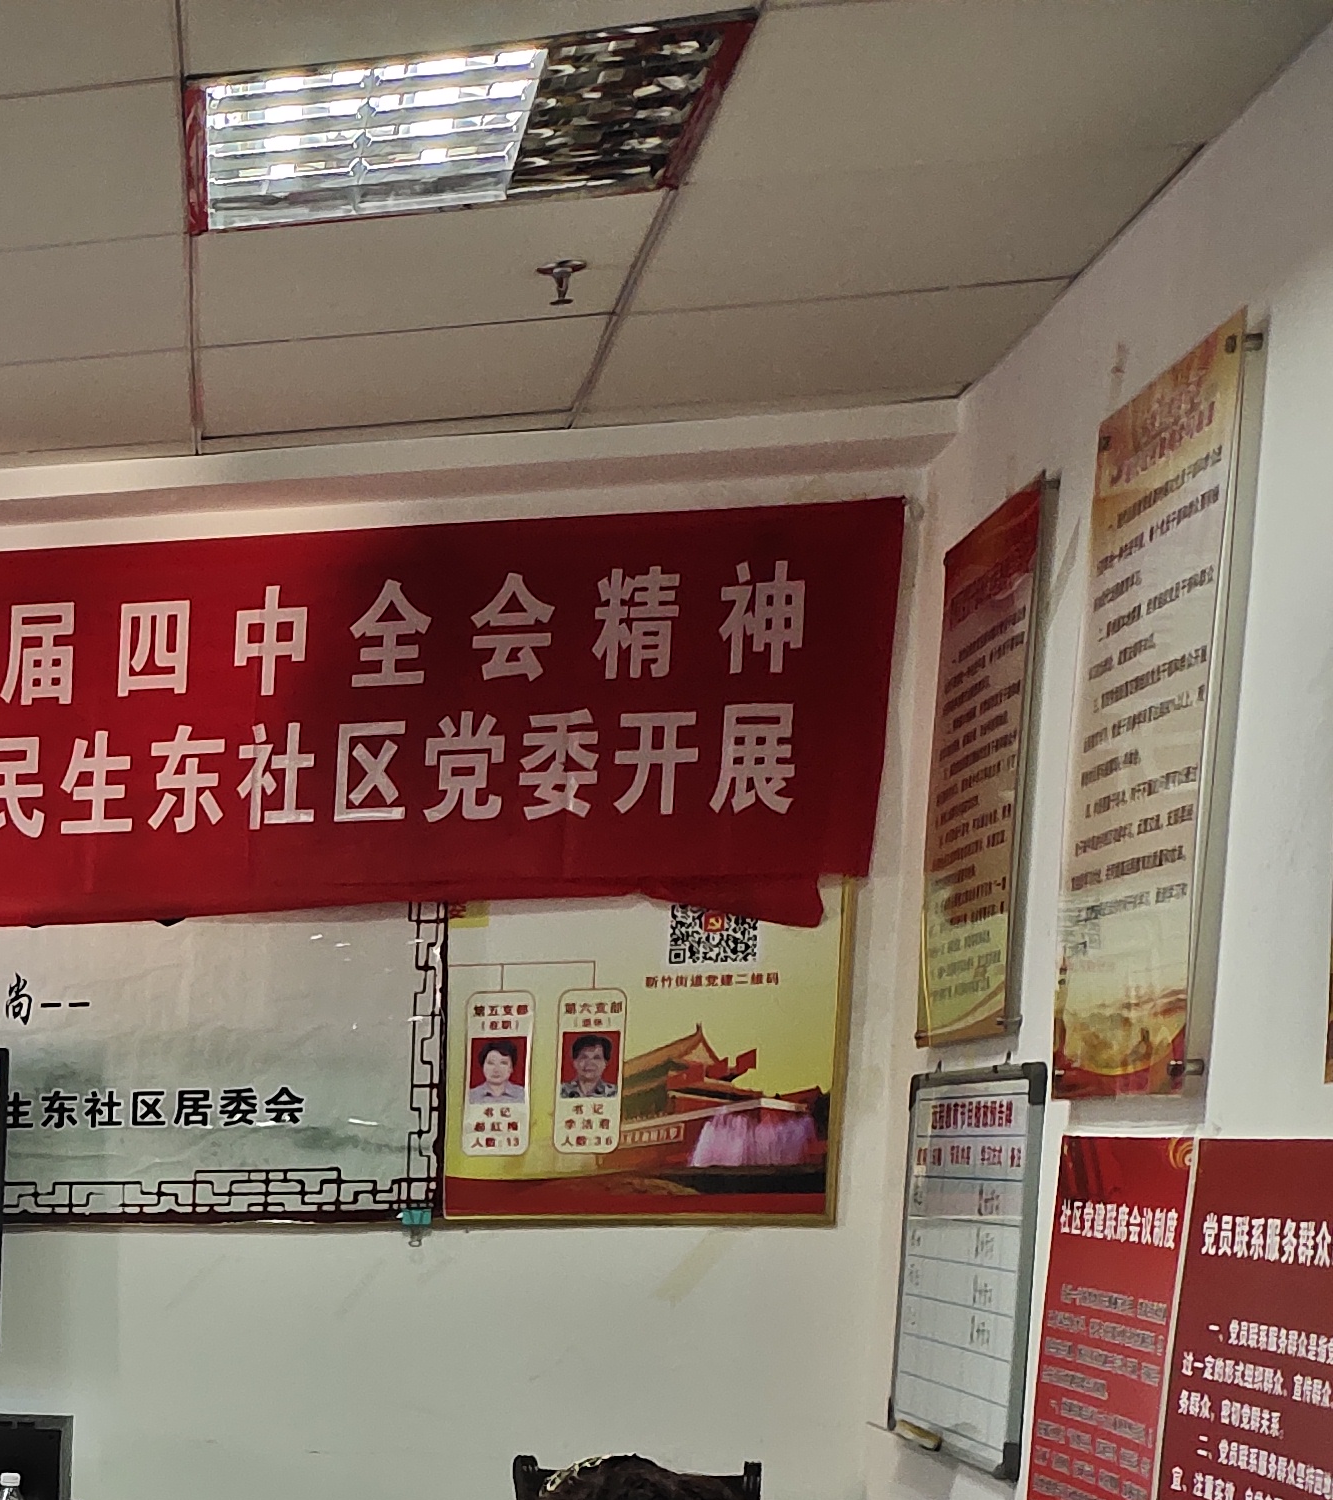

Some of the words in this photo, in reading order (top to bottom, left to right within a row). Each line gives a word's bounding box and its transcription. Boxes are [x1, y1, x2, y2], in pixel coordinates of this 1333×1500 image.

[1060, 1200, 1179, 1251] 社区党建联席会议制度
